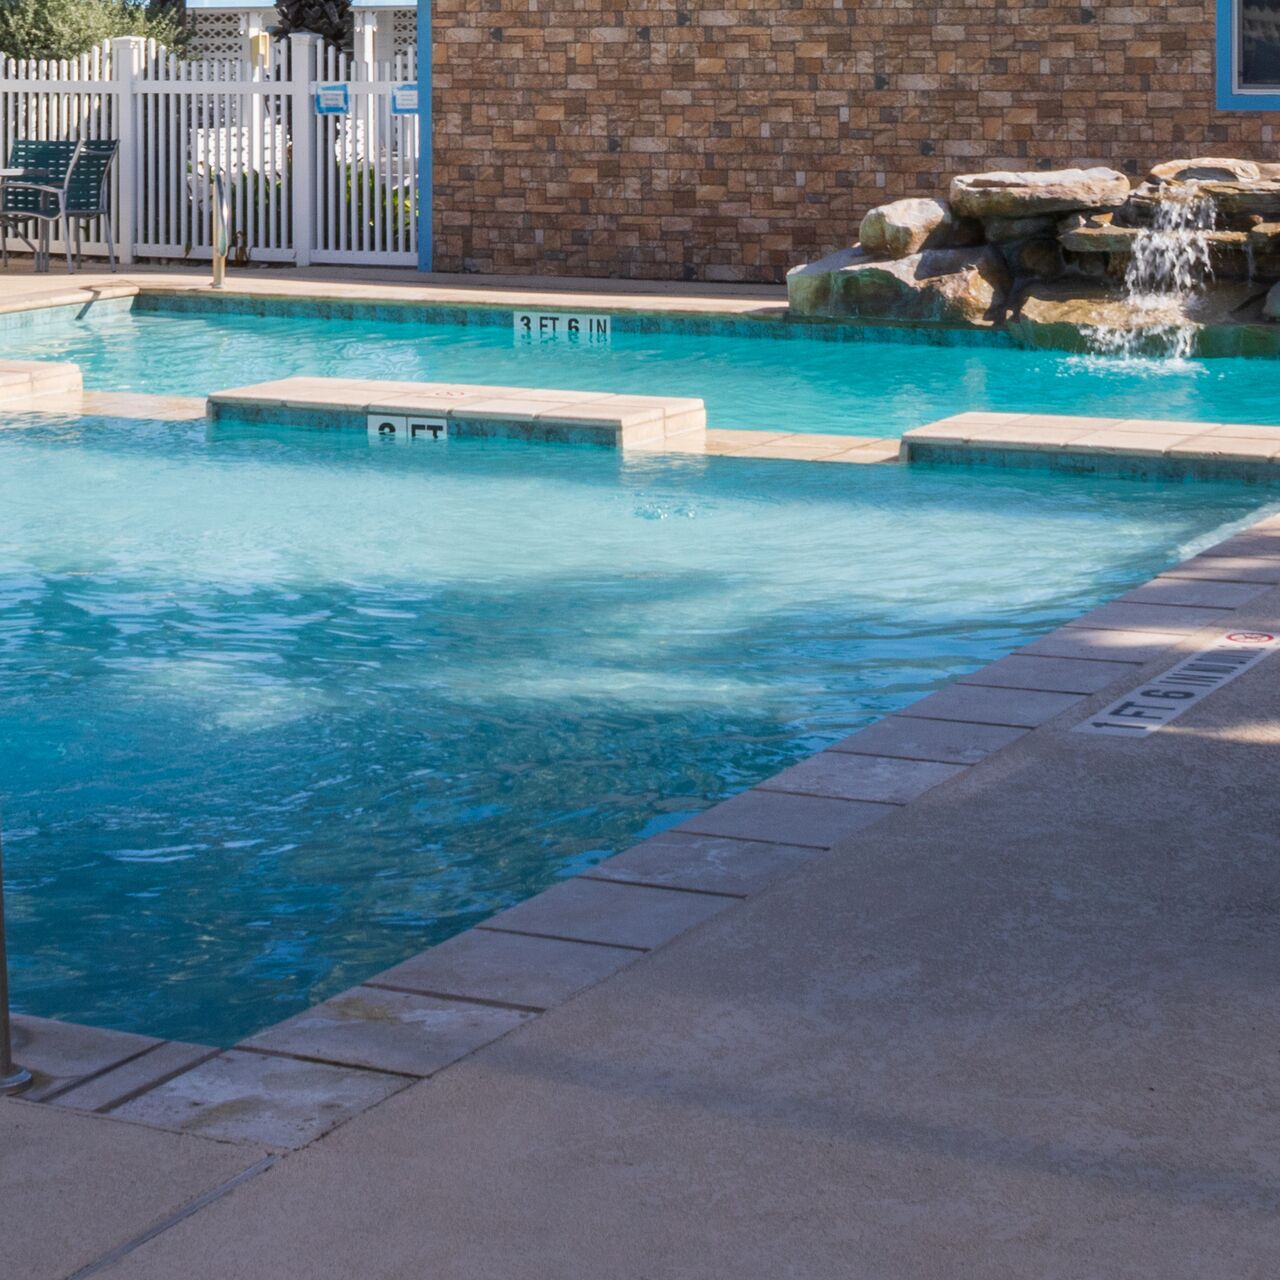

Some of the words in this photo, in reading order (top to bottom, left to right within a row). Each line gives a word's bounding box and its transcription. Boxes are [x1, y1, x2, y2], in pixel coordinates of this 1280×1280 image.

[519, 315, 531, 333] 3
[539, 316, 559, 333] FT
[568, 318, 580, 333] 6
[589, 318, 607, 334] IN
[1140, 689, 1196, 700] 6
[1109, 701, 1176, 720] FT
[1091, 721, 1148, 730] 1
